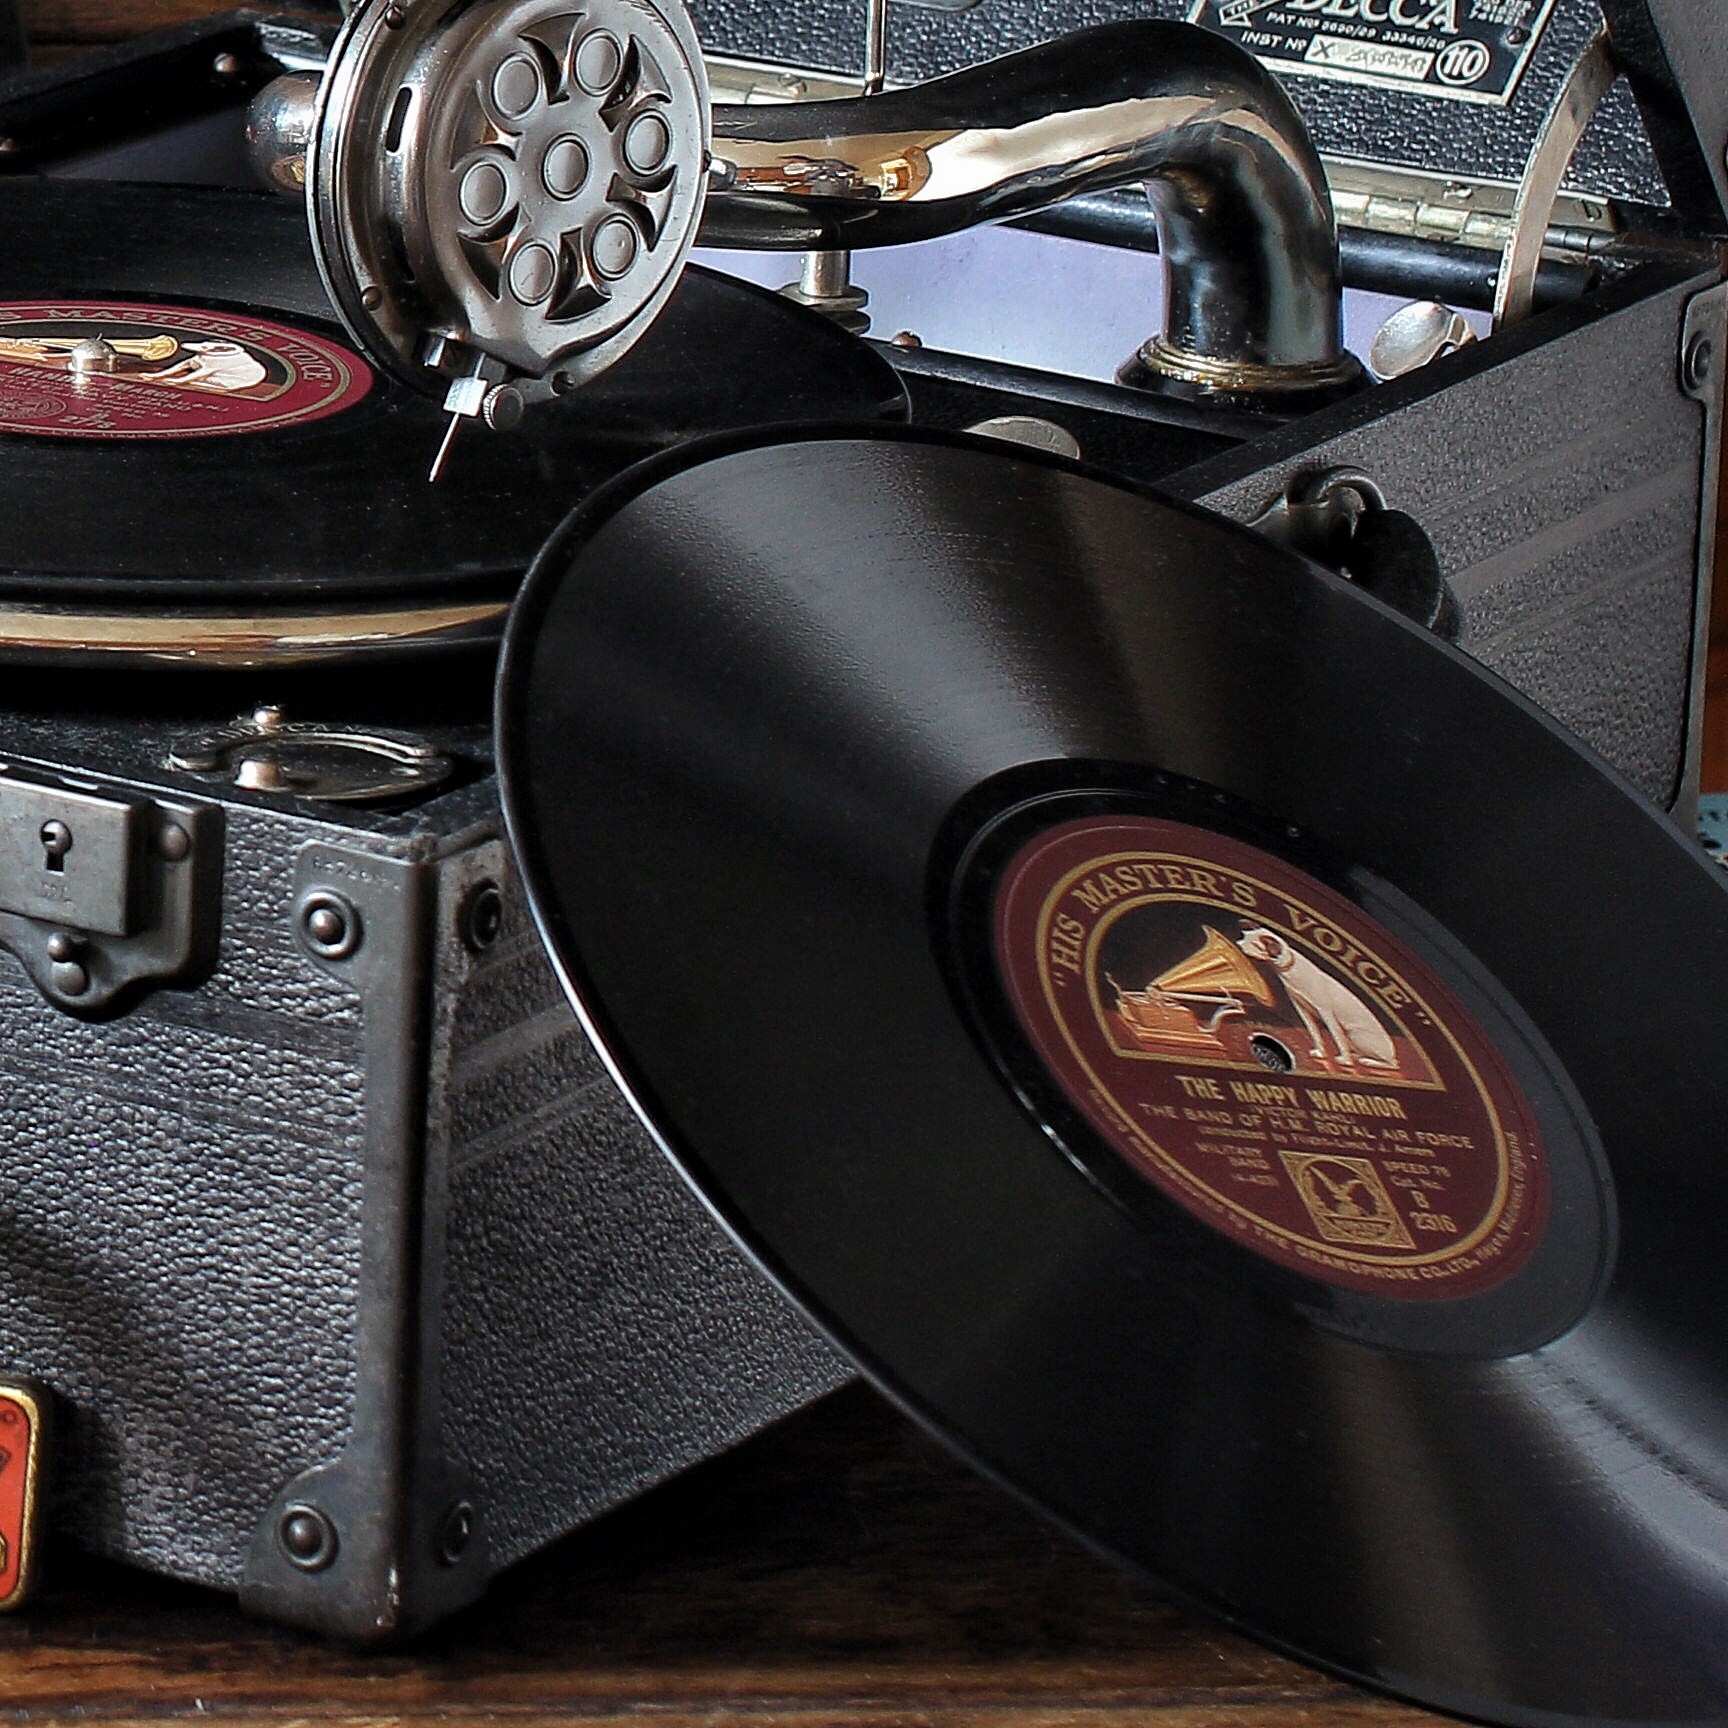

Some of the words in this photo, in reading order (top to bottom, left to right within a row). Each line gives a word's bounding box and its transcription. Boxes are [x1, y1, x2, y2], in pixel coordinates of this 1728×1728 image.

[1265, 11, 1297, 25] PAT
[1240, 29, 1283, 49] INST
[1442, 44, 1484, 79] 110
[48, 307, 271, 341] MASTER'S
[1071, 862, 1258, 915] MASTER'S
[1174, 1074, 1227, 1101] THE
[1229, 1080, 1301, 1109] HAPPY
[1305, 1087, 1409, 1121] WARRIOR
[1137, 1101, 1180, 1120] THE
[1182, 1106, 1234, 1125] BAND
[1238, 1112, 1264, 1128] OF
[1312, 1120, 1378, 1140] ROYAL
[1380, 1128, 1413, 1143] AIR
[1414, 1130, 1476, 1150] FORCE
